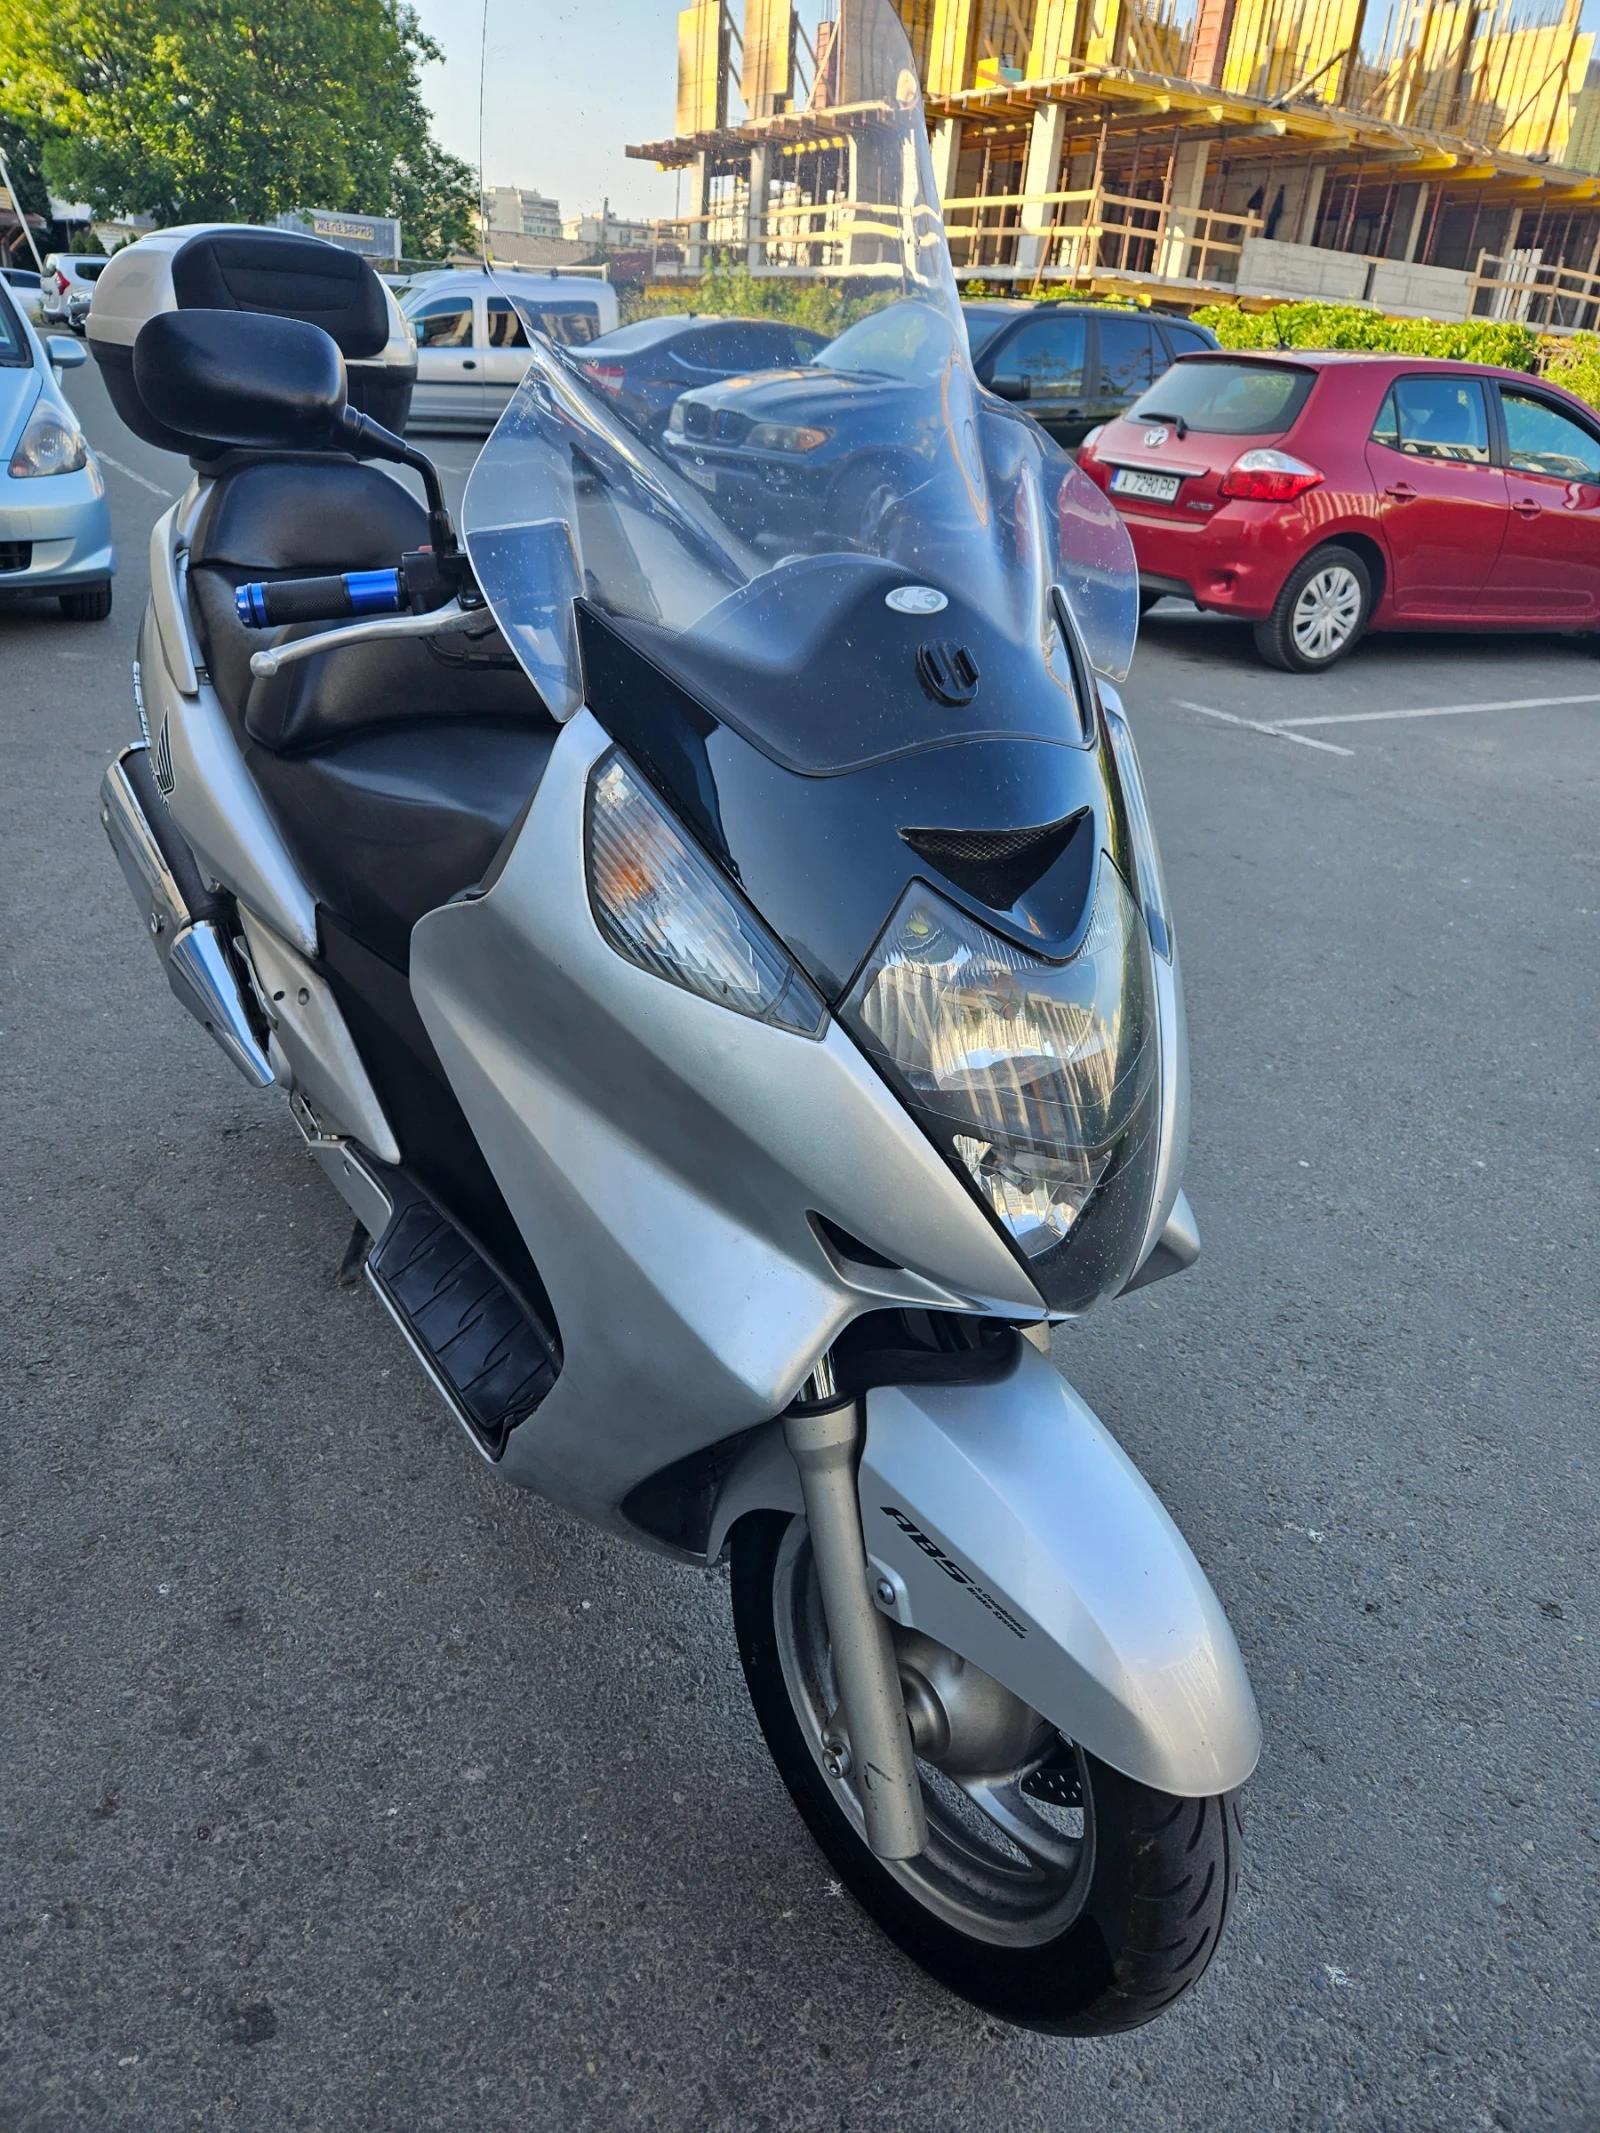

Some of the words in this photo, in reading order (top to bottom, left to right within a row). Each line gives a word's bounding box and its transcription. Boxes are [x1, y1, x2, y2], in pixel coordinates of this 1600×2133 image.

[317, 221, 374, 238] ЖЕЛЕЗАРИЯ
[880, 1506, 976, 1584] ABS
[966, 1587, 993, 1610] Brake
[992, 1611, 1026, 1639] System
